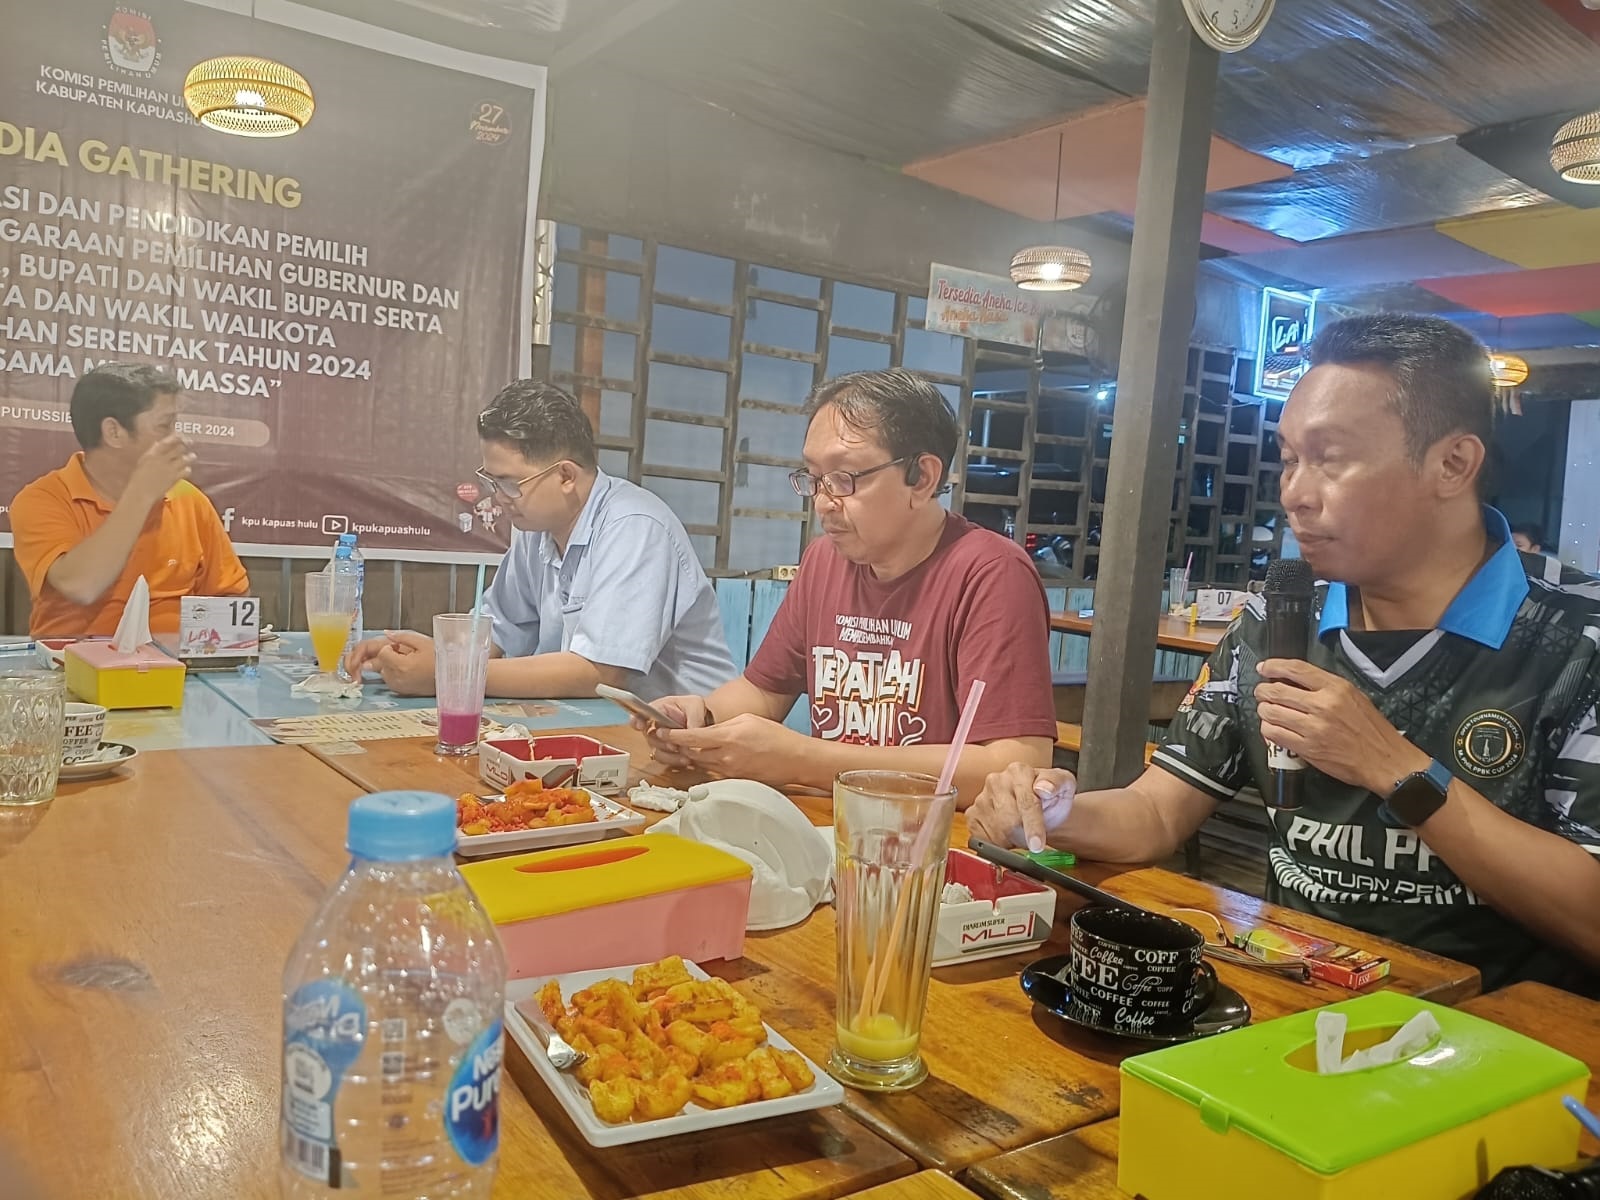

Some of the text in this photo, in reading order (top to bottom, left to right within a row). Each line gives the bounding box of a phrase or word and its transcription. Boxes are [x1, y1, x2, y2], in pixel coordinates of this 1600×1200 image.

[35, 80, 124, 110] KABUPATEN
[40, 64, 94, 88] KOMISI
[98, 78, 168, 104] PEMILIHAN
[479, 103, 504, 124] 27
[0, 121, 302, 209] DIA GATHERING
[0, 185, 368, 267] SI DAN PENDIDIKAN PEMILIH
[0, 218, 459, 310] GARAAN PEMILIHAN GUBERNUR DAN
[20, 253, 443, 335] BUPATI DAN WAKIL BUPATI SERTA
[937, 279, 982, 305] Tersedia
[982, 289, 1013, 311] Aneka
[34, 287, 96, 317] DAN
[104, 297, 194, 330] WAKIL
[200, 309, 337, 348] WALIKOTA
[66, 324, 208, 362] SERENTAK
[214, 342, 300, 373] TAHUN
[307, 353, 372, 381] 2024
[205, 423, 235, 437] 2024
[241, 516, 319, 531] kpu kapuas hulu
[352, 522, 431, 537] kpukapuashulu
[1217, 591, 1232, 606] 07
[228, 600, 255, 627] 12
[1286, 815, 1375, 867] PHIL
[961, 924, 1027, 944] MLD
[1090, 946, 1124, 966] Coffee
[1134, 949, 1179, 964] COFF
[1071, 948, 1119, 990] FEE
[1147, 965, 1177, 973] COFFEE
[1090, 986, 1134, 1007] COFFEE
[1122, 973, 1163, 997] Coffee
[1141, 999, 1169, 1008] COFFEE
[1114, 1006, 1155, 1026] Coffee
